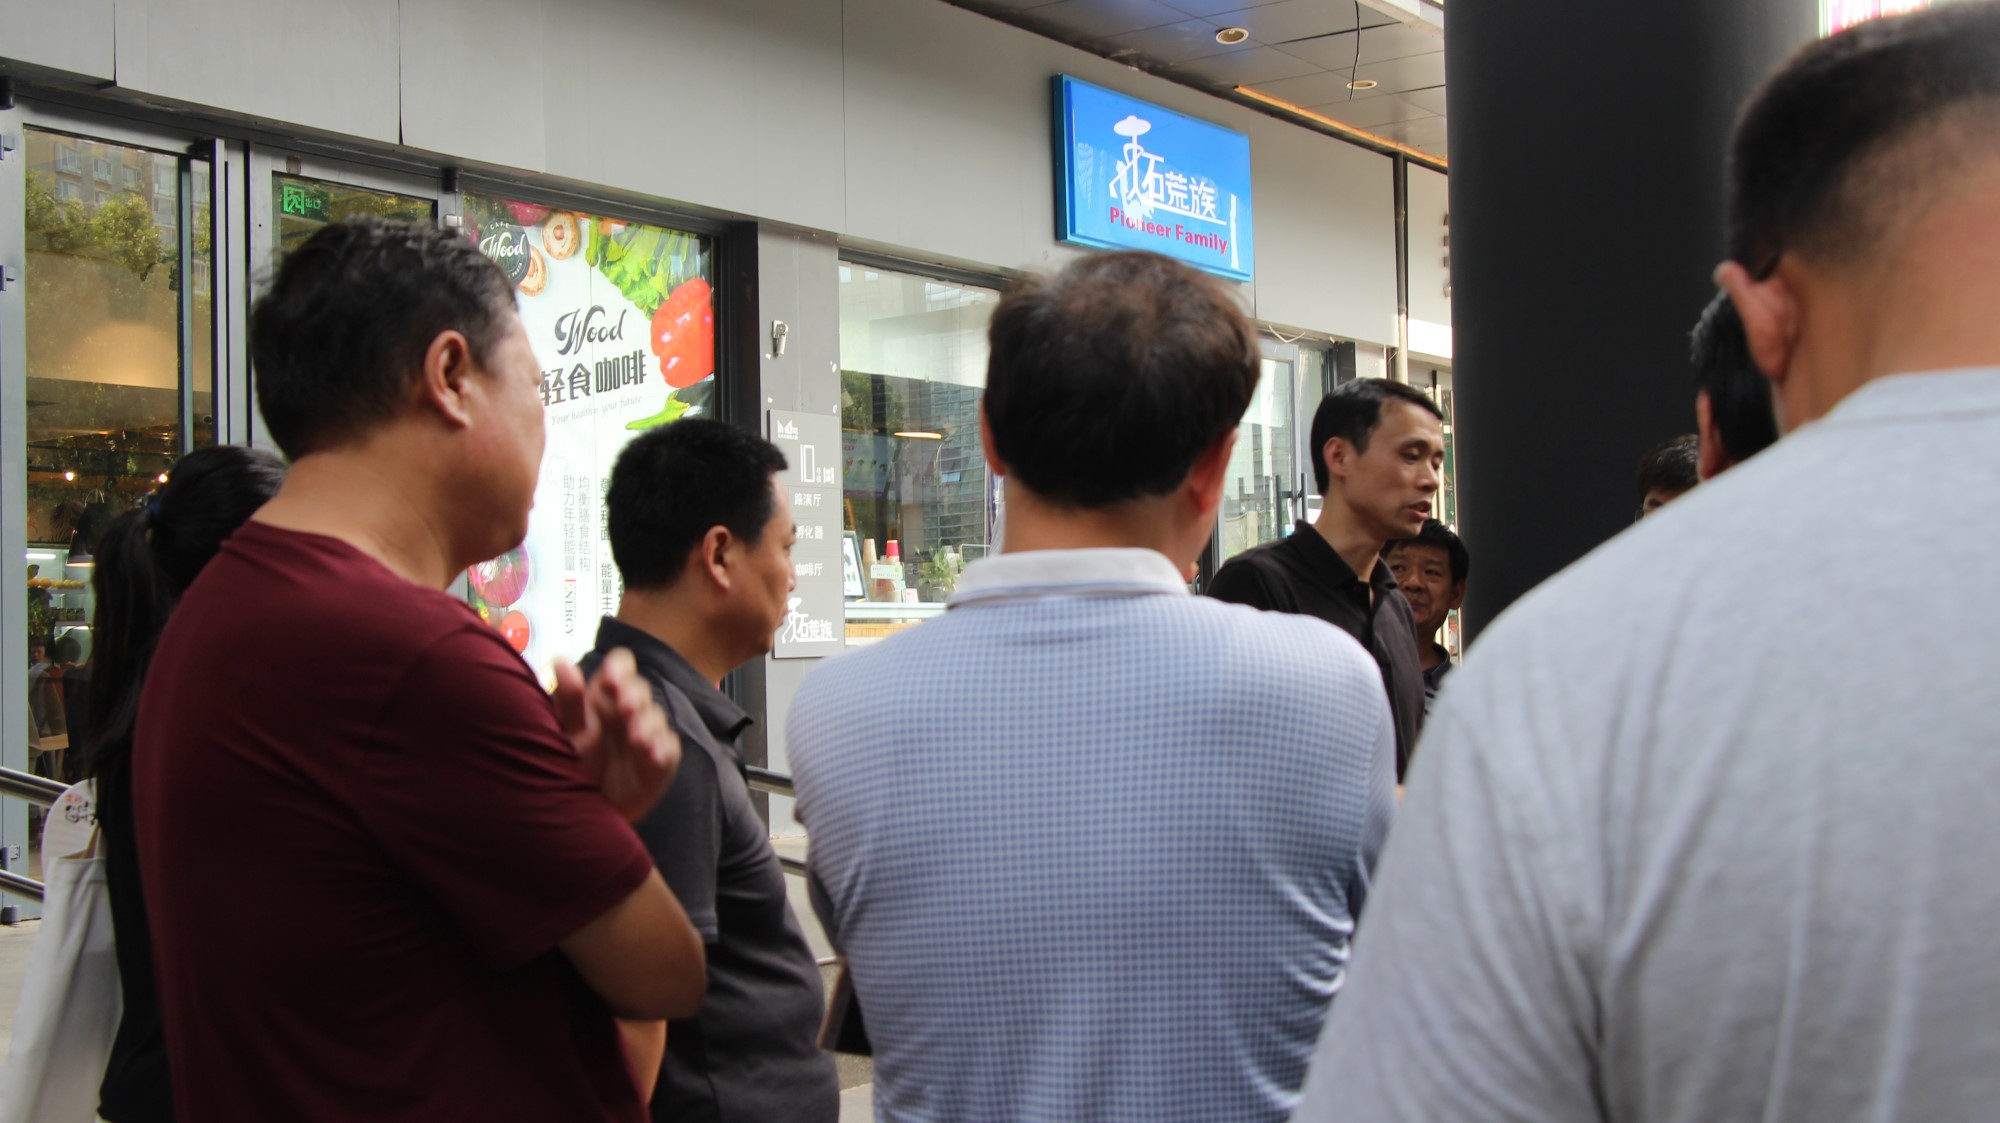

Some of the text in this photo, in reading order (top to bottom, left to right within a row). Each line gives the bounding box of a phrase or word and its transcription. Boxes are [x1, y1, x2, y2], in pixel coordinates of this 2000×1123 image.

[479, 232, 525, 262] Wood
[1110, 206, 1228, 255] Pioneer Family
[555, 305, 627, 355] Wood
[540, 349, 647, 407] 轻食咖啡
[552, 415, 569, 426] Your
[602, 400, 618, 416] your
[620, 395, 642, 411] future
[563, 475, 576, 571] 助力年轻能量
[578, 475, 591, 572] 均衡膳食结构
[794, 493, 821, 507] 路演厅
